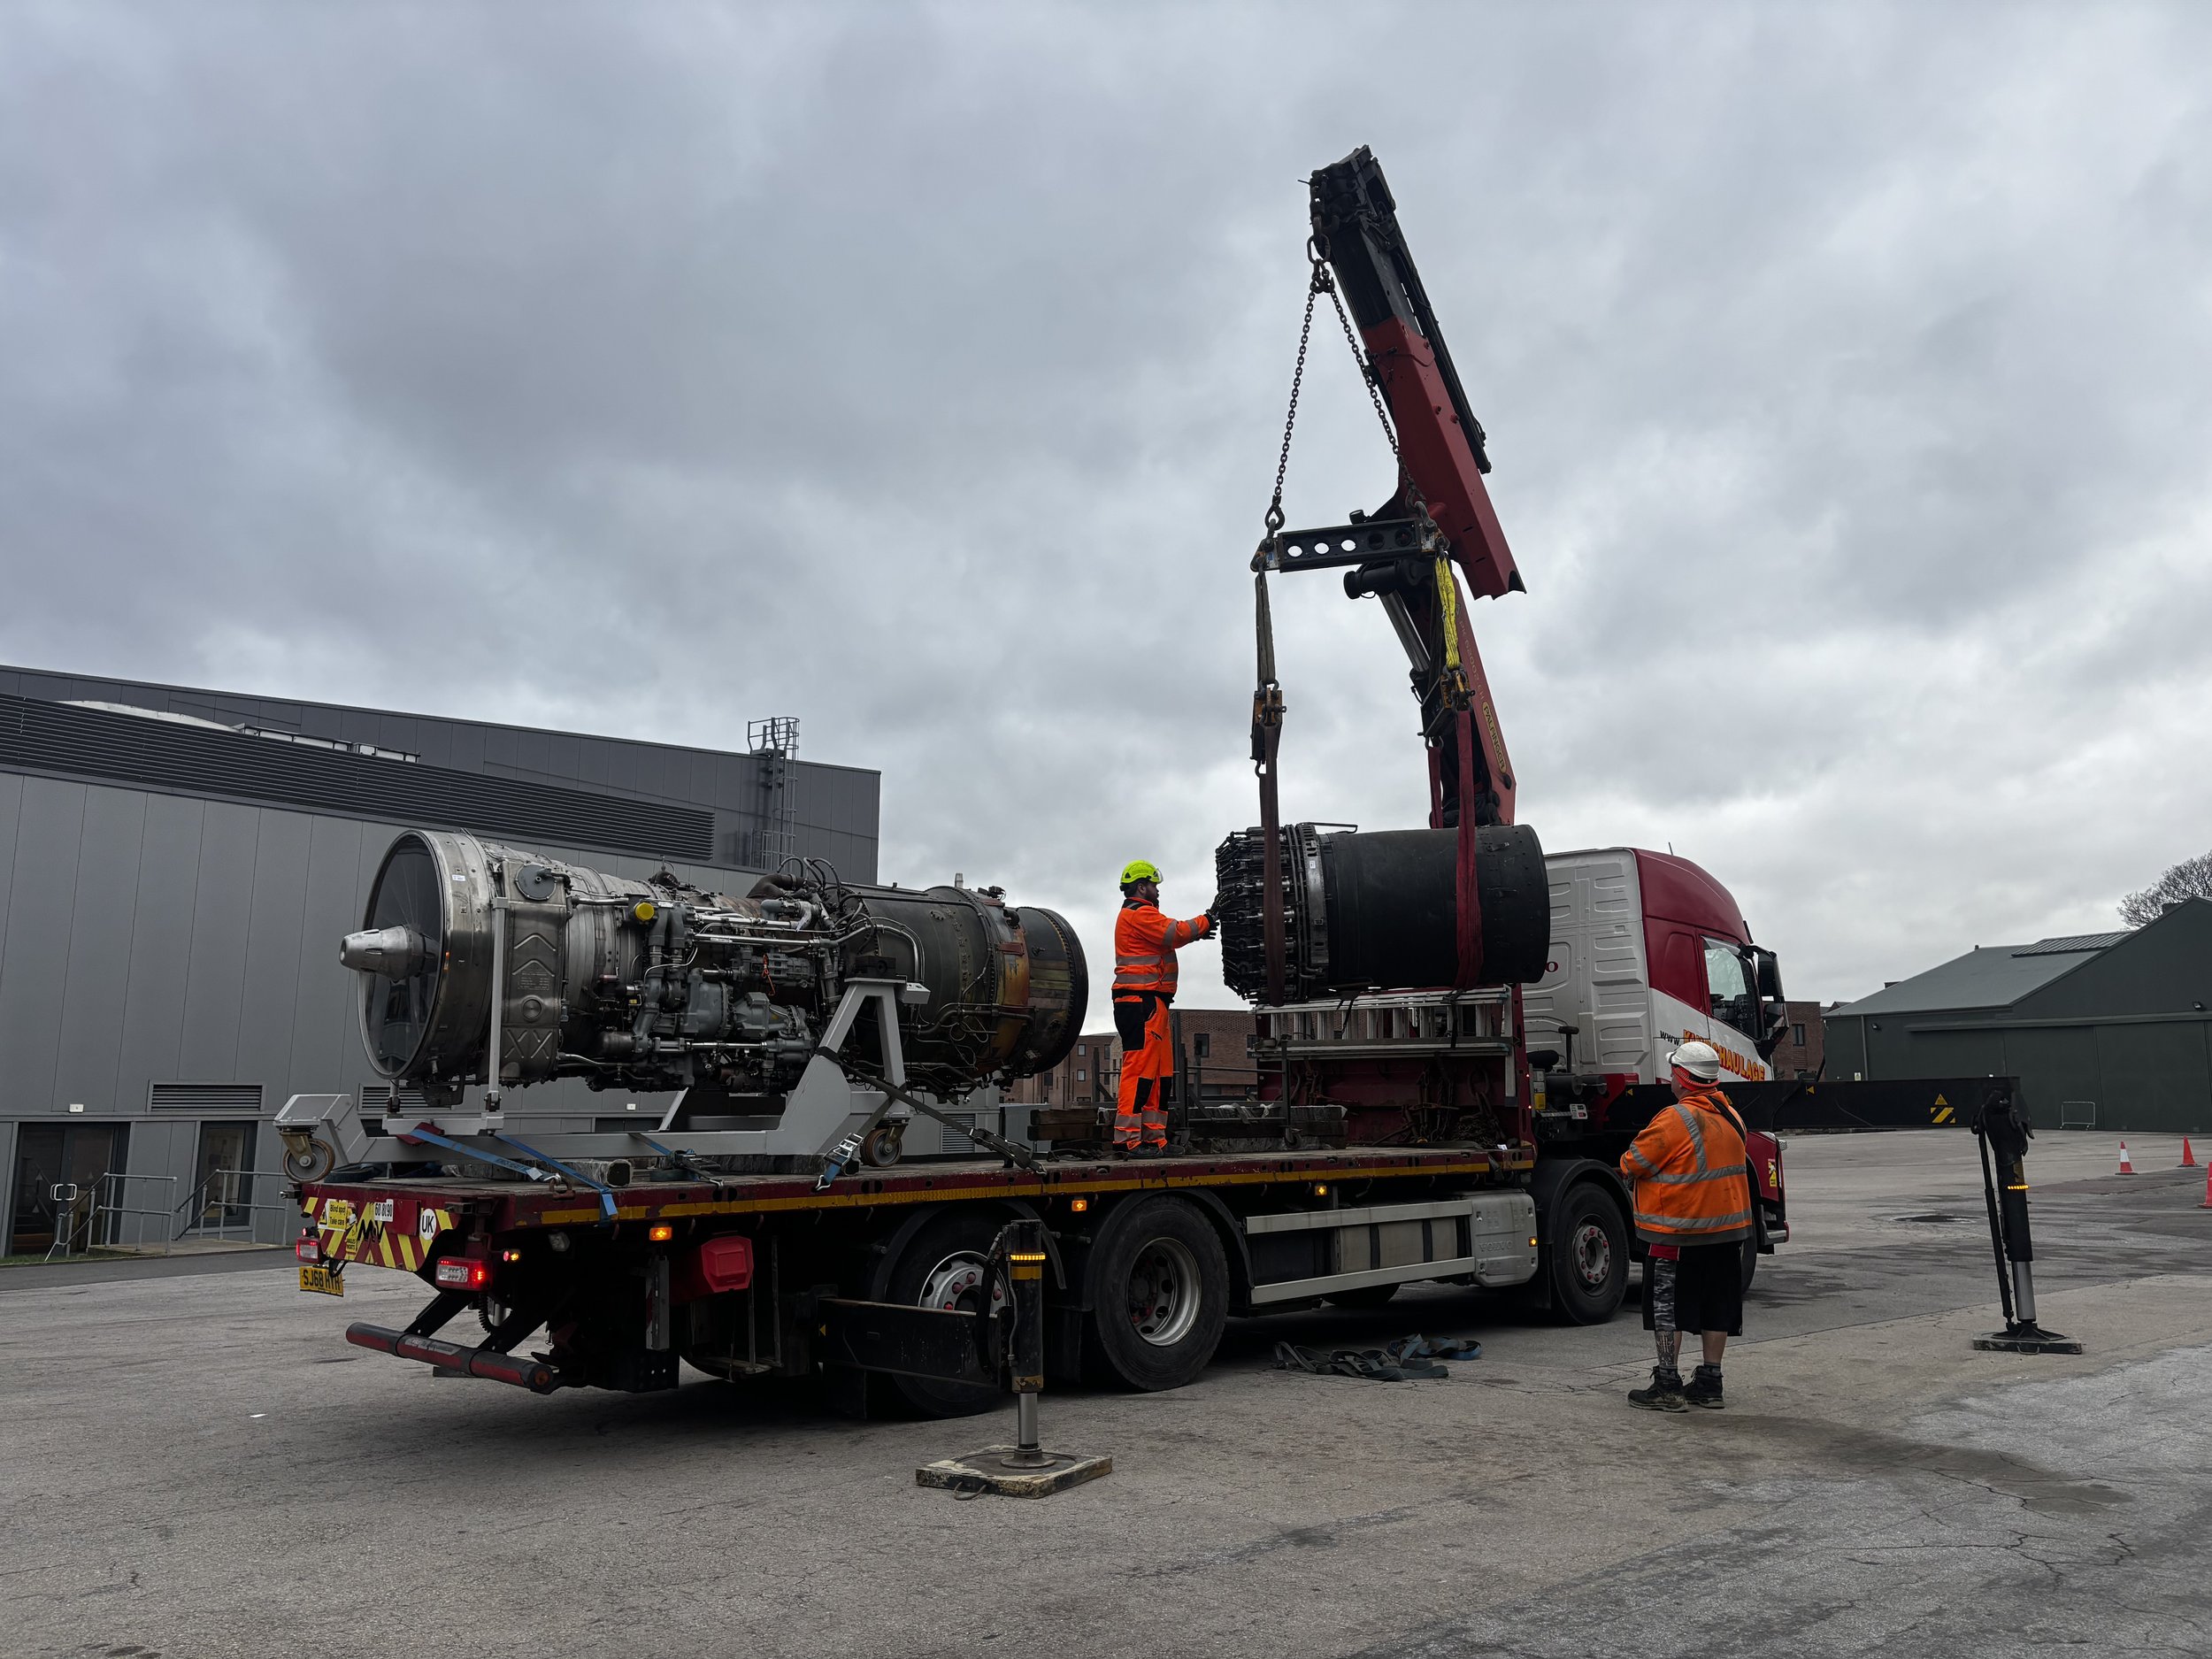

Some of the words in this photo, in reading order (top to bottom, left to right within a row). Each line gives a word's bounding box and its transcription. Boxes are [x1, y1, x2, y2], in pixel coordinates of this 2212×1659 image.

[1483, 705, 1505, 770] PALFINGER
[421, 1215, 434, 1233] UK
[1479, 1240, 1513, 1252] VOLVO
[303, 1269, 324, 1287] SJ68
